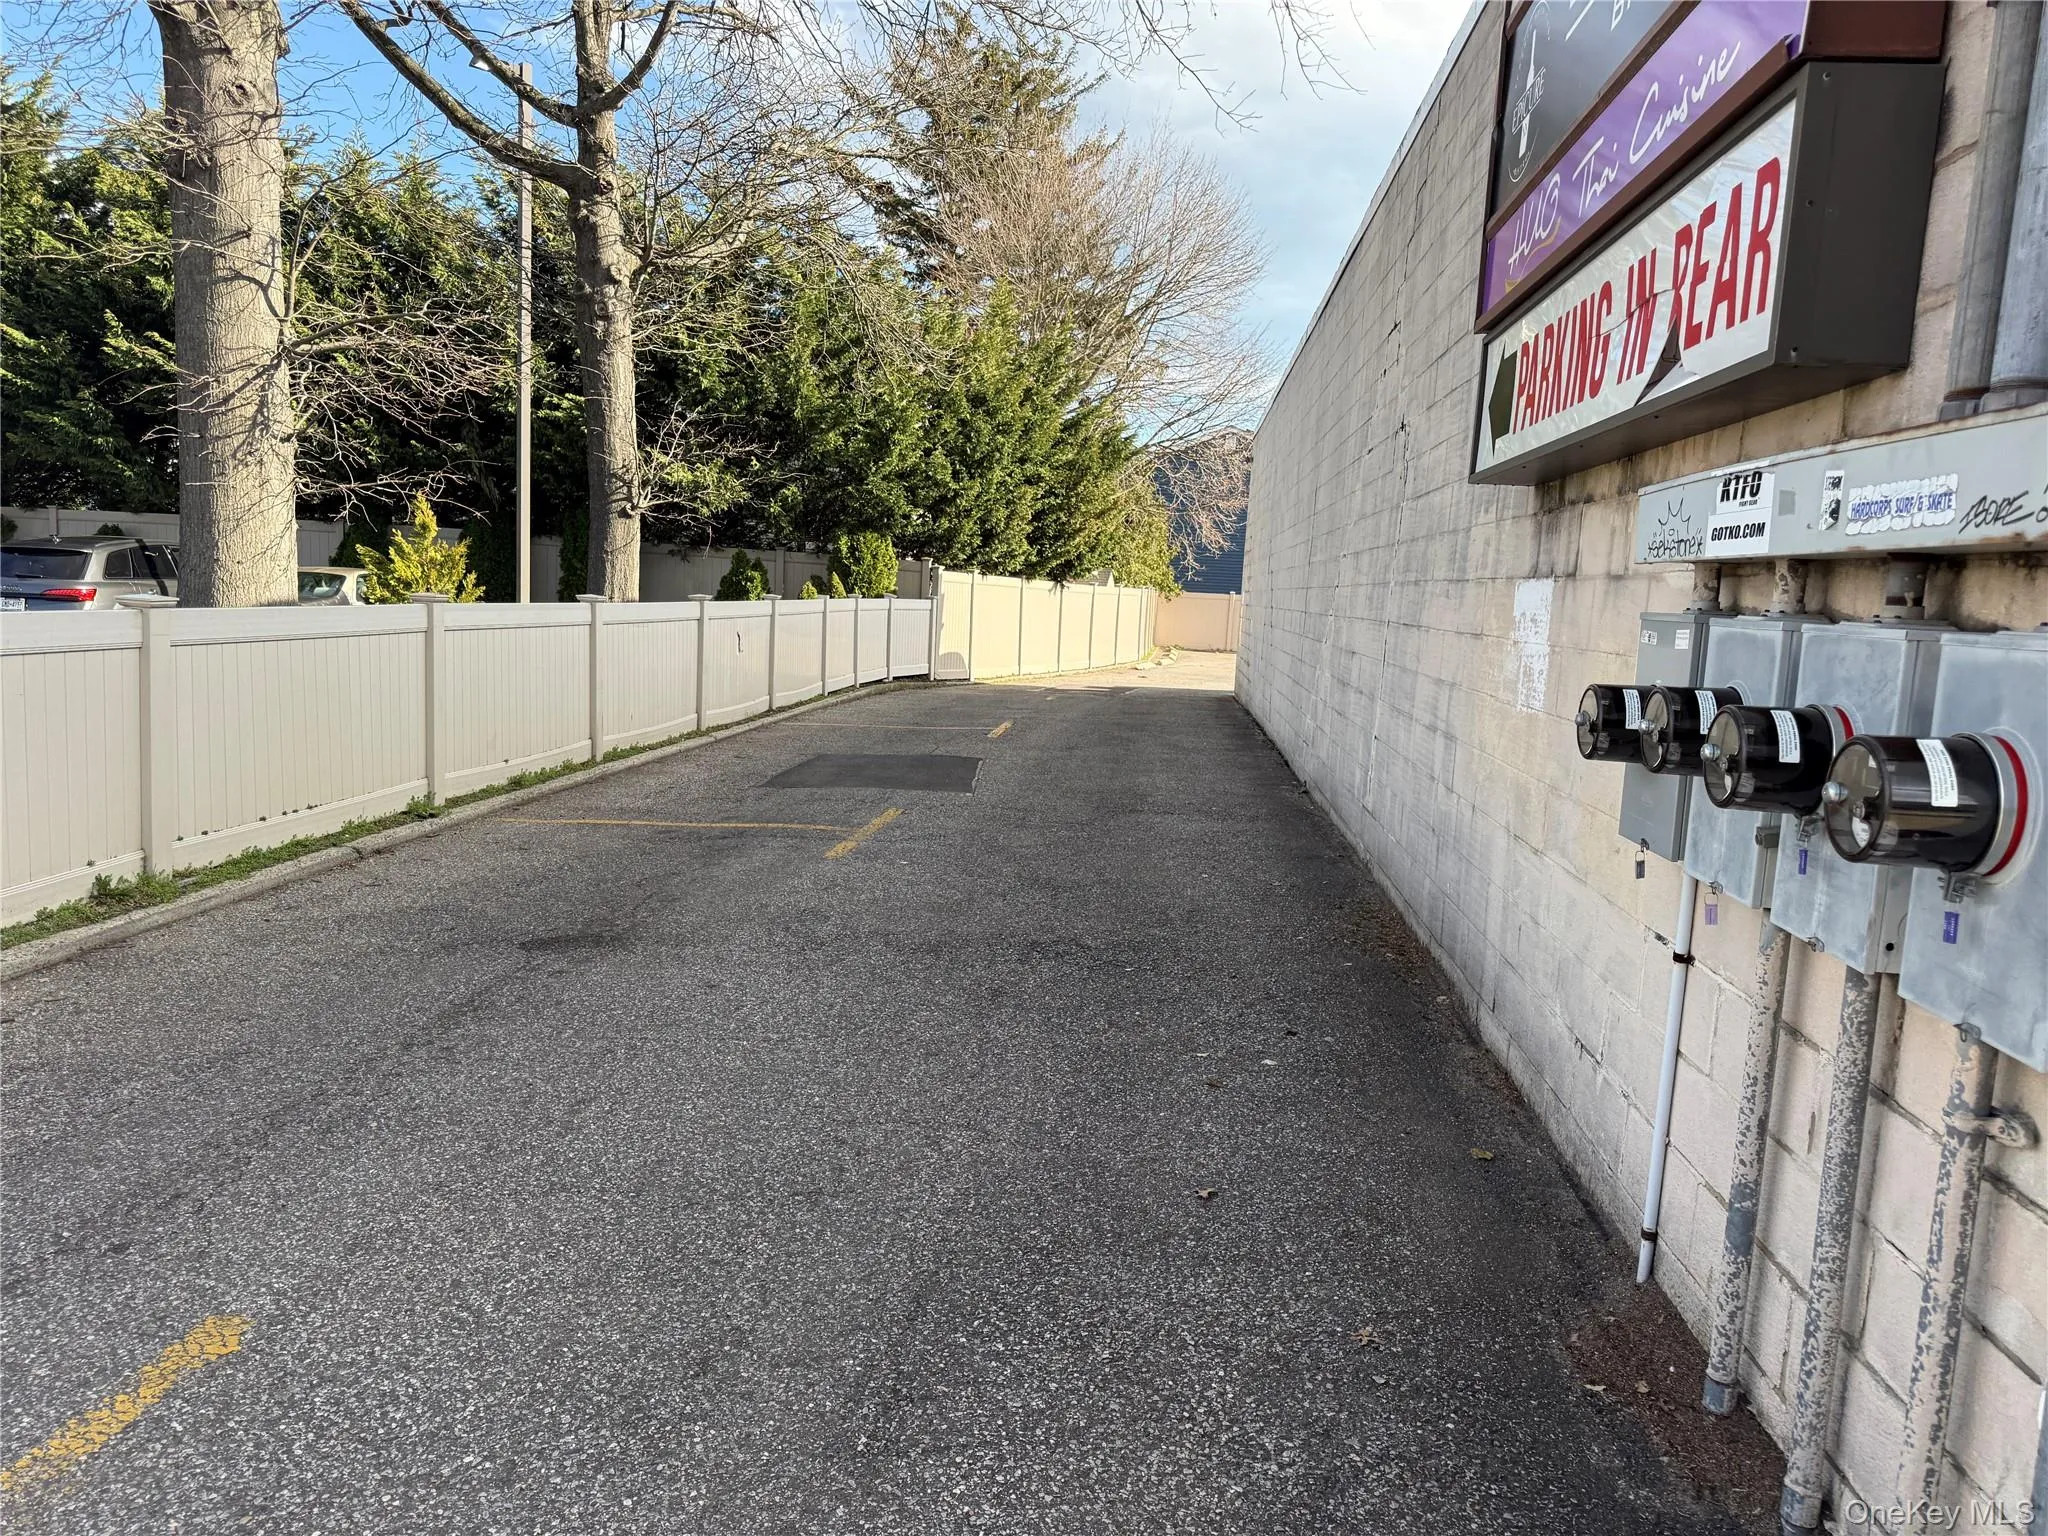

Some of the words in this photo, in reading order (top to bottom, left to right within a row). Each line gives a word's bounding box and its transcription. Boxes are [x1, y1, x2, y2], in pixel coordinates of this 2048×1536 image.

[1511, 68, 1546, 133] EPICURE
[1572, 136, 1619, 217] Thai
[1629, 40, 1742, 165] Cuisine
[1512, 280, 1613, 435] PARKING
[1616, 247, 1658, 385] IN
[1667, 156, 1781, 351] REAR
[1711, 522, 1766, 541] GOTKO.COM
[1851, 497, 1892, 520] HARDCORPS
[1895, 495, 1916, 514] SURF
[1927, 491, 1953, 511] SKATE
